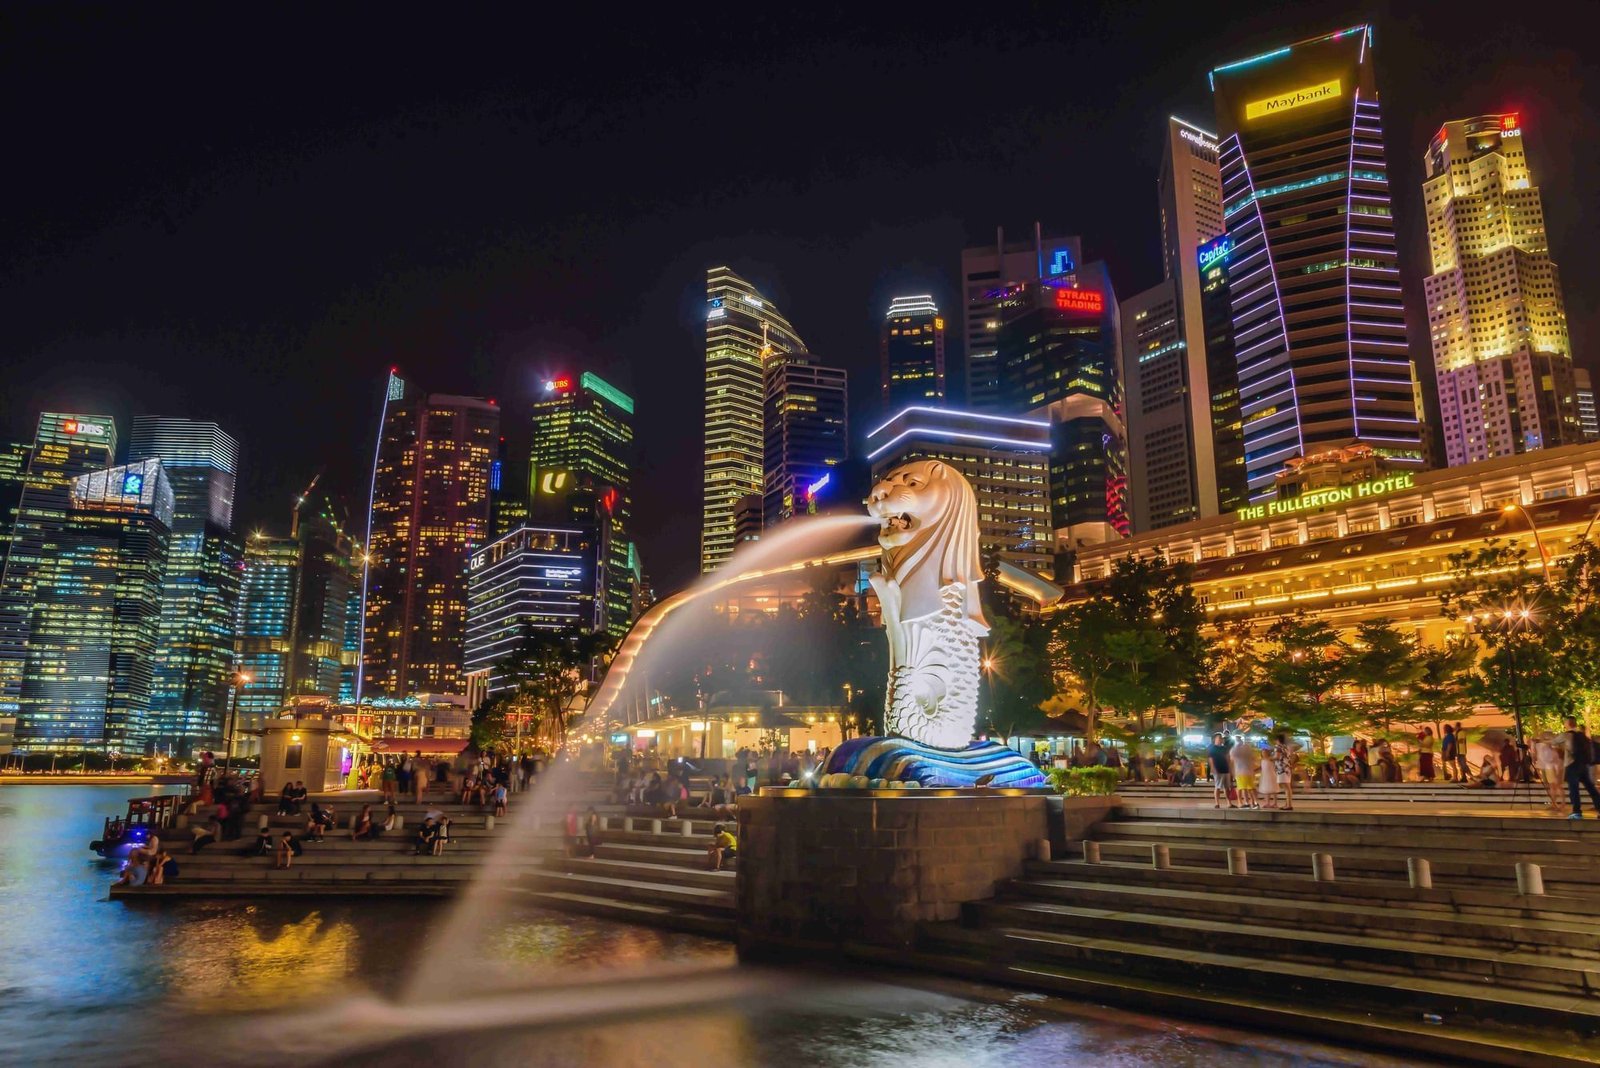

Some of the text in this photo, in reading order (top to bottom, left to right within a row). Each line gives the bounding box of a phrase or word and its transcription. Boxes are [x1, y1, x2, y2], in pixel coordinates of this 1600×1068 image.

[1266, 86, 1331, 110] Maybank
[1501, 129, 1521, 138] UOB
[1058, 289, 1101, 301] STRAITS
[1057, 299, 1102, 311] TRADING
[554, 380, 568, 389] UBS
[77, 423, 104, 436] DBS
[1237, 474, 1414, 521] THE FULLERTON HOTEL
[471, 554, 485, 570] OUE
